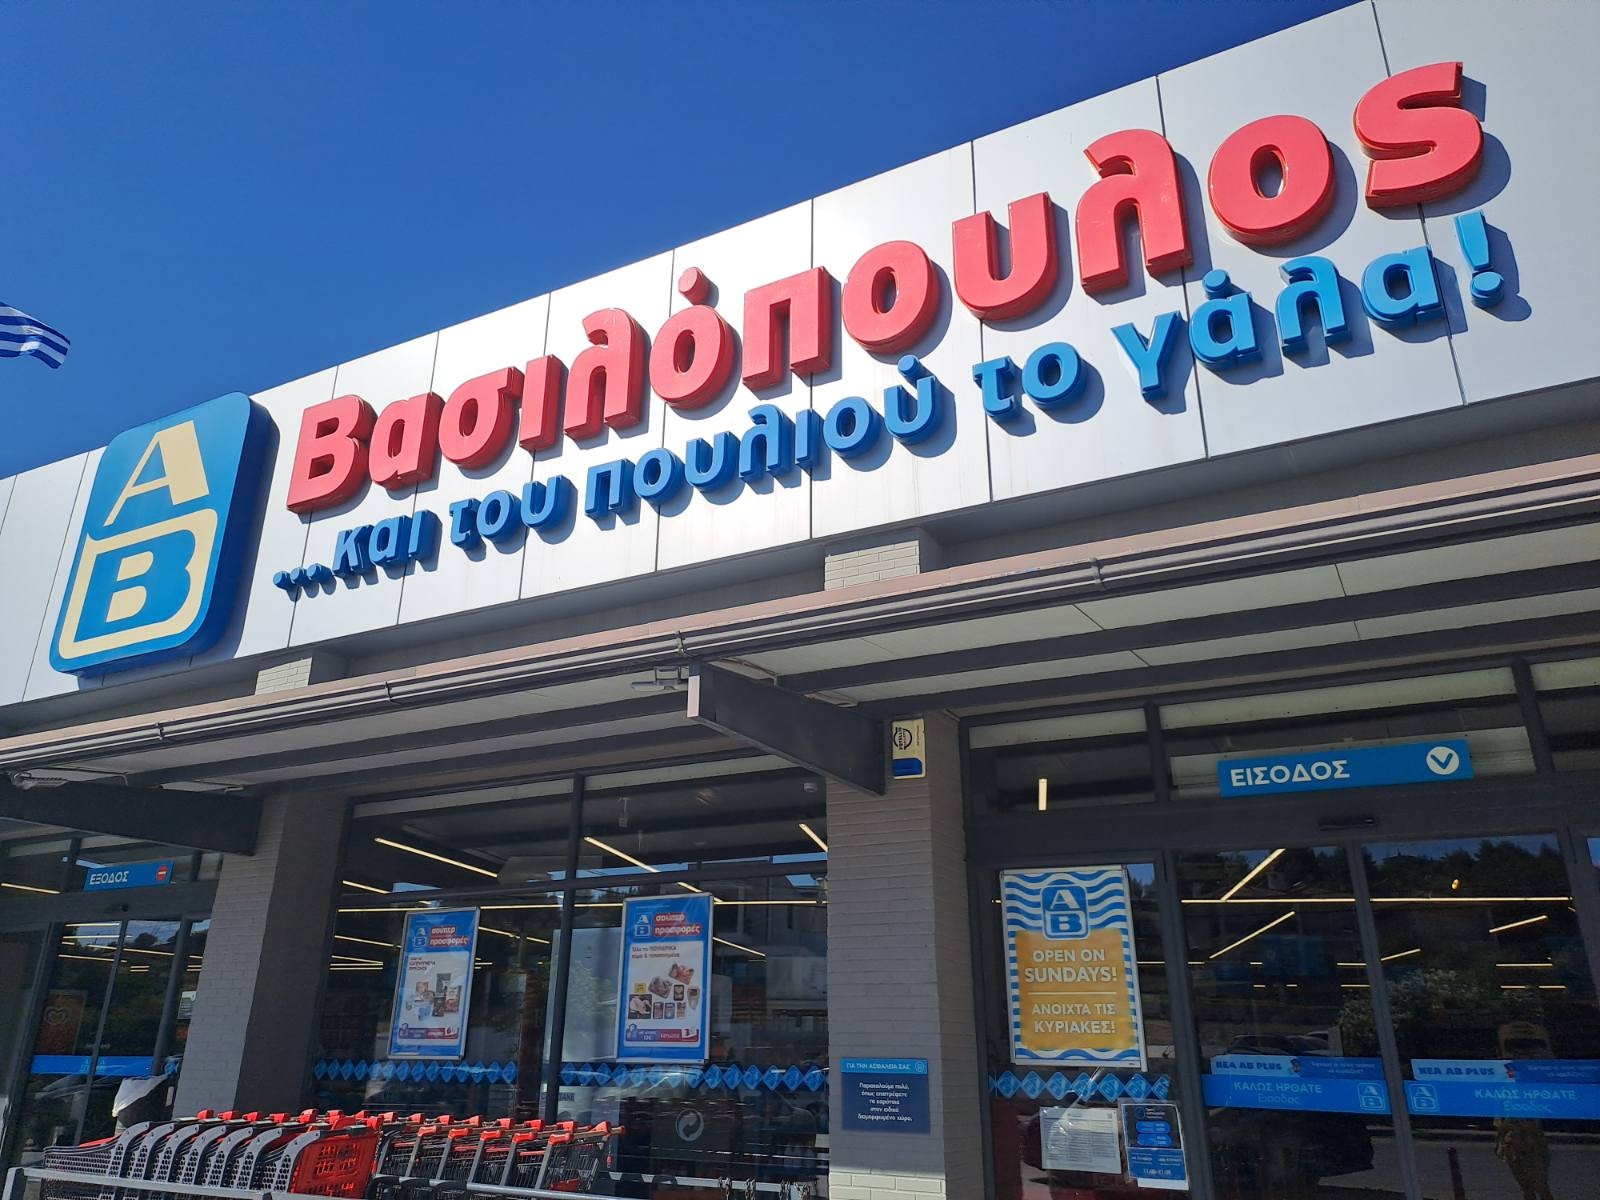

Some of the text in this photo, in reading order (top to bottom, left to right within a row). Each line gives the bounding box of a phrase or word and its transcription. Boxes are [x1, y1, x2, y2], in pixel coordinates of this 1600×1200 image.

[449, 474, 573, 550] του
[584, 354, 938, 520] πουλιού
[973, 340, 1085, 420] το
[1230, 760, 1350, 787] ΕΙΣΟΔΟΣ
[89, 870, 130, 885] ΕΞΟΔΟΣ
[1032, 948, 1105, 962] OPEN ON
[1024, 966, 1118, 983] SUNDAYS!
[1032, 1003, 1116, 1015] ΑΝΟΙΧΤΑ ΤΙΣ
[1034, 1020, 1116, 1034] ΚΥΡΙΑΚΕΣ!
[1233, 1081, 1273, 1092] ΚΑΛΩΣ
[1474, 1088, 1520, 1099] ΚΑΛΩΣ
